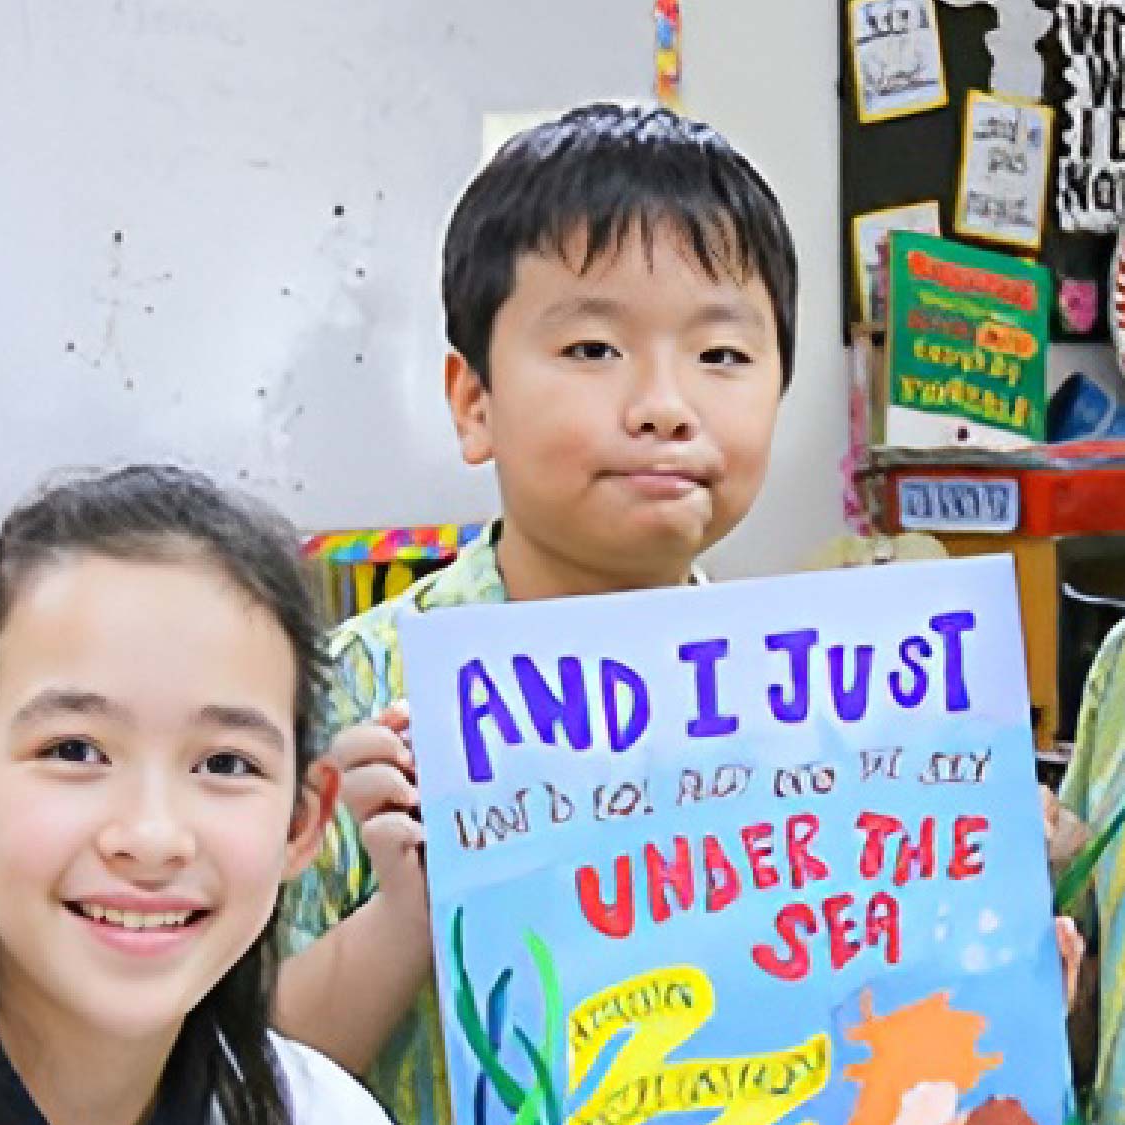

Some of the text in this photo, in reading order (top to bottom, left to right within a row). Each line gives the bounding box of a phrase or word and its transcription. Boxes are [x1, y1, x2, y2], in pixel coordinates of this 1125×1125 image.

[458, 611, 975, 783] AND I JUST
[576, 813, 829, 939] UNDER
[856, 811, 988, 886] THE
[751, 891, 900, 982] SEA
